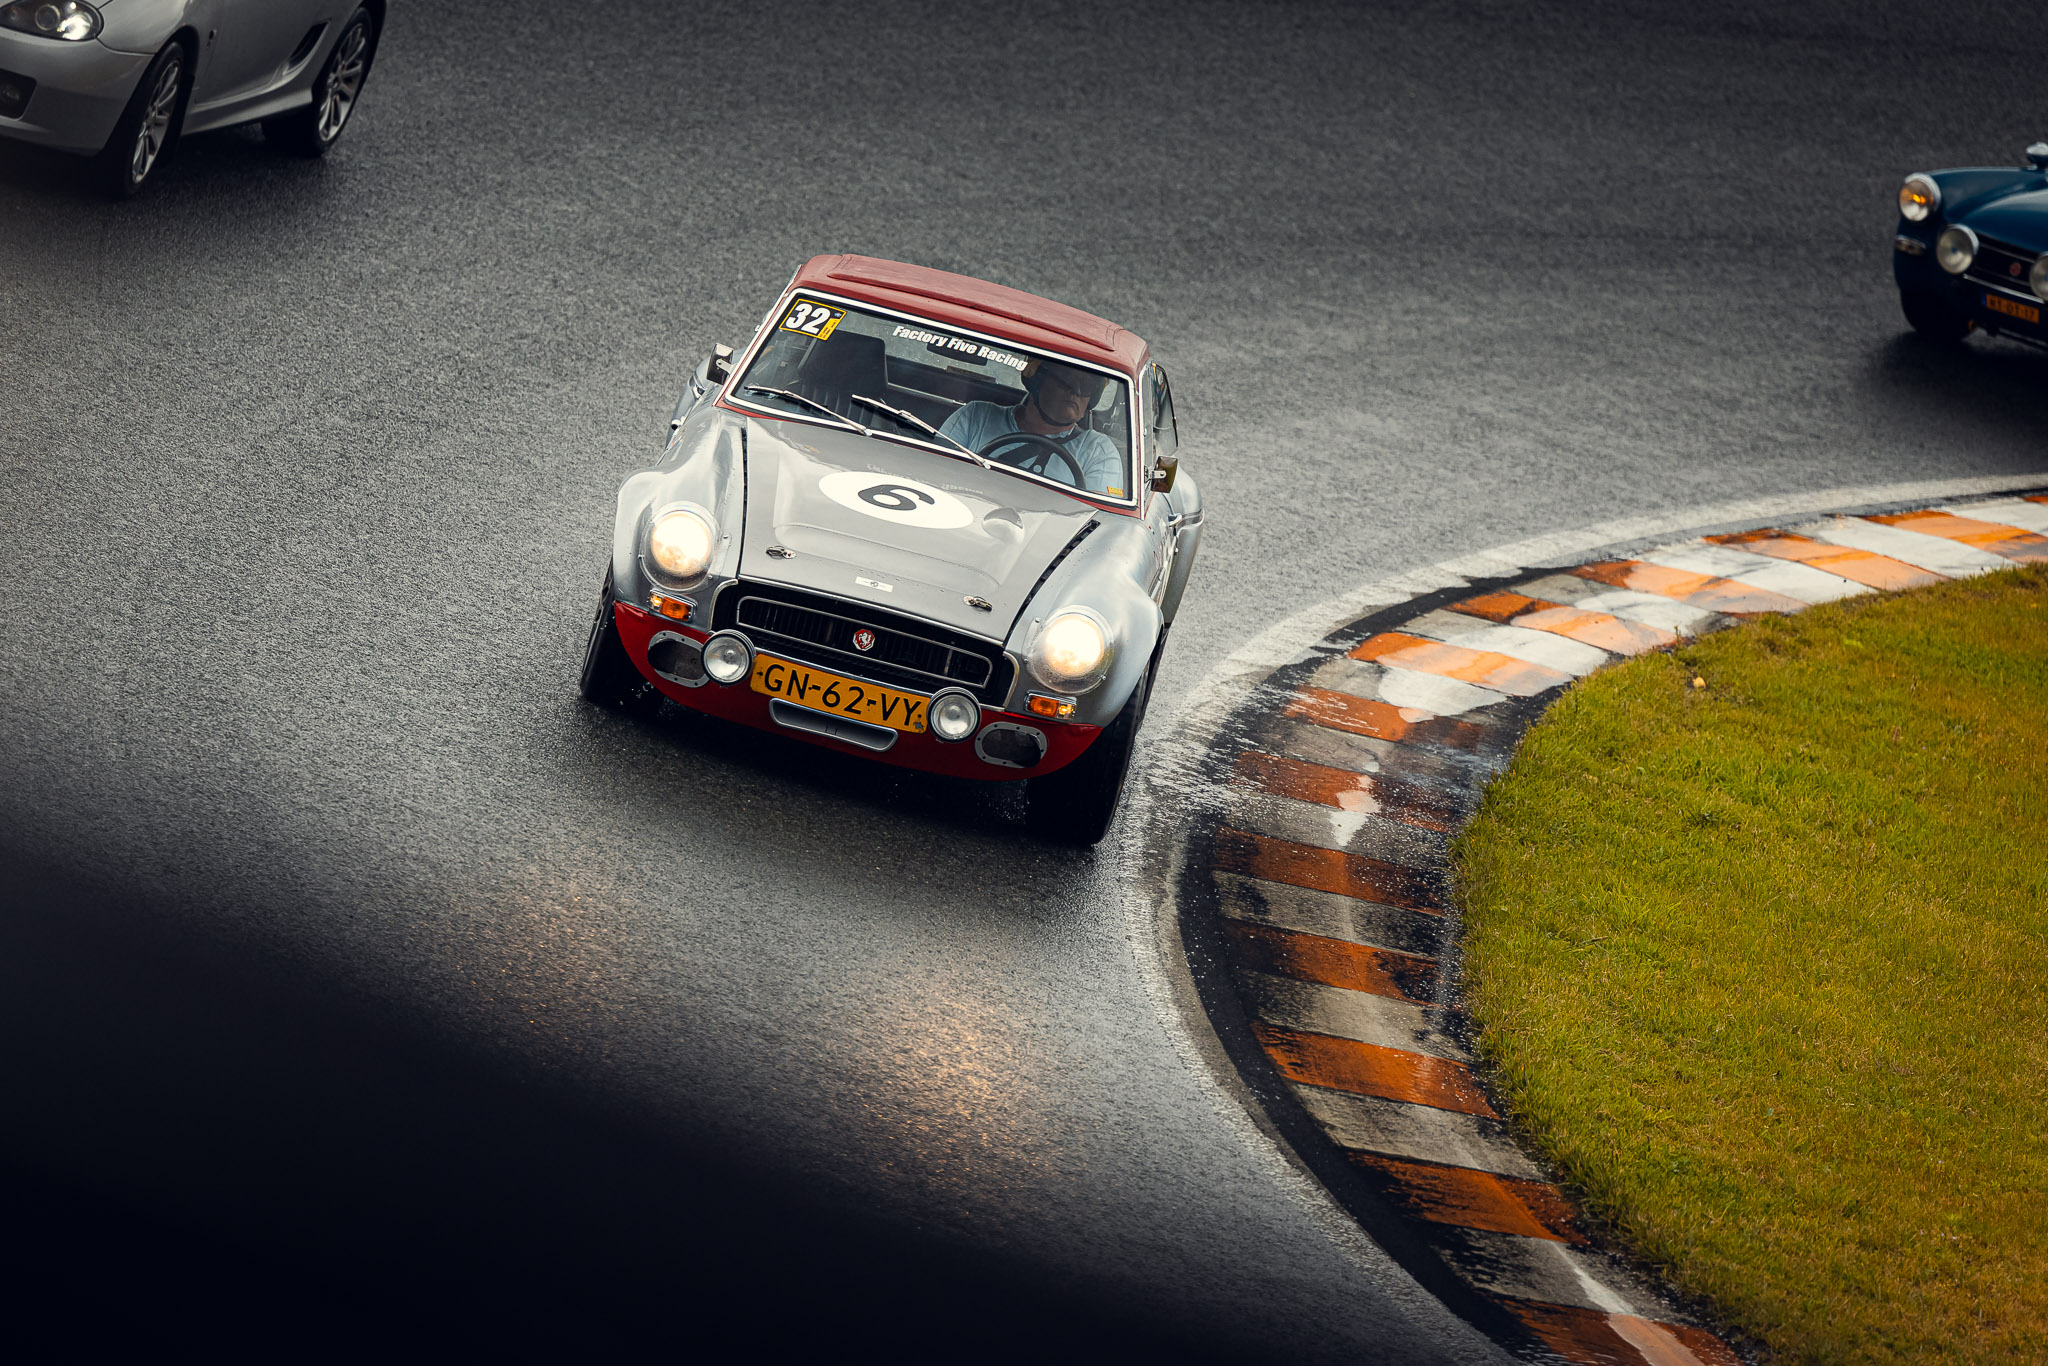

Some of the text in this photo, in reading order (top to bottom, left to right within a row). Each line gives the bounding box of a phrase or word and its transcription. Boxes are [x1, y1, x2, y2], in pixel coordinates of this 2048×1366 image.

[785, 303, 831, 335] 32
[892, 325, 1029, 372] Factory Five Racing
[857, 484, 936, 512] 6
[764, 663, 922, 727] GN-62-VY
